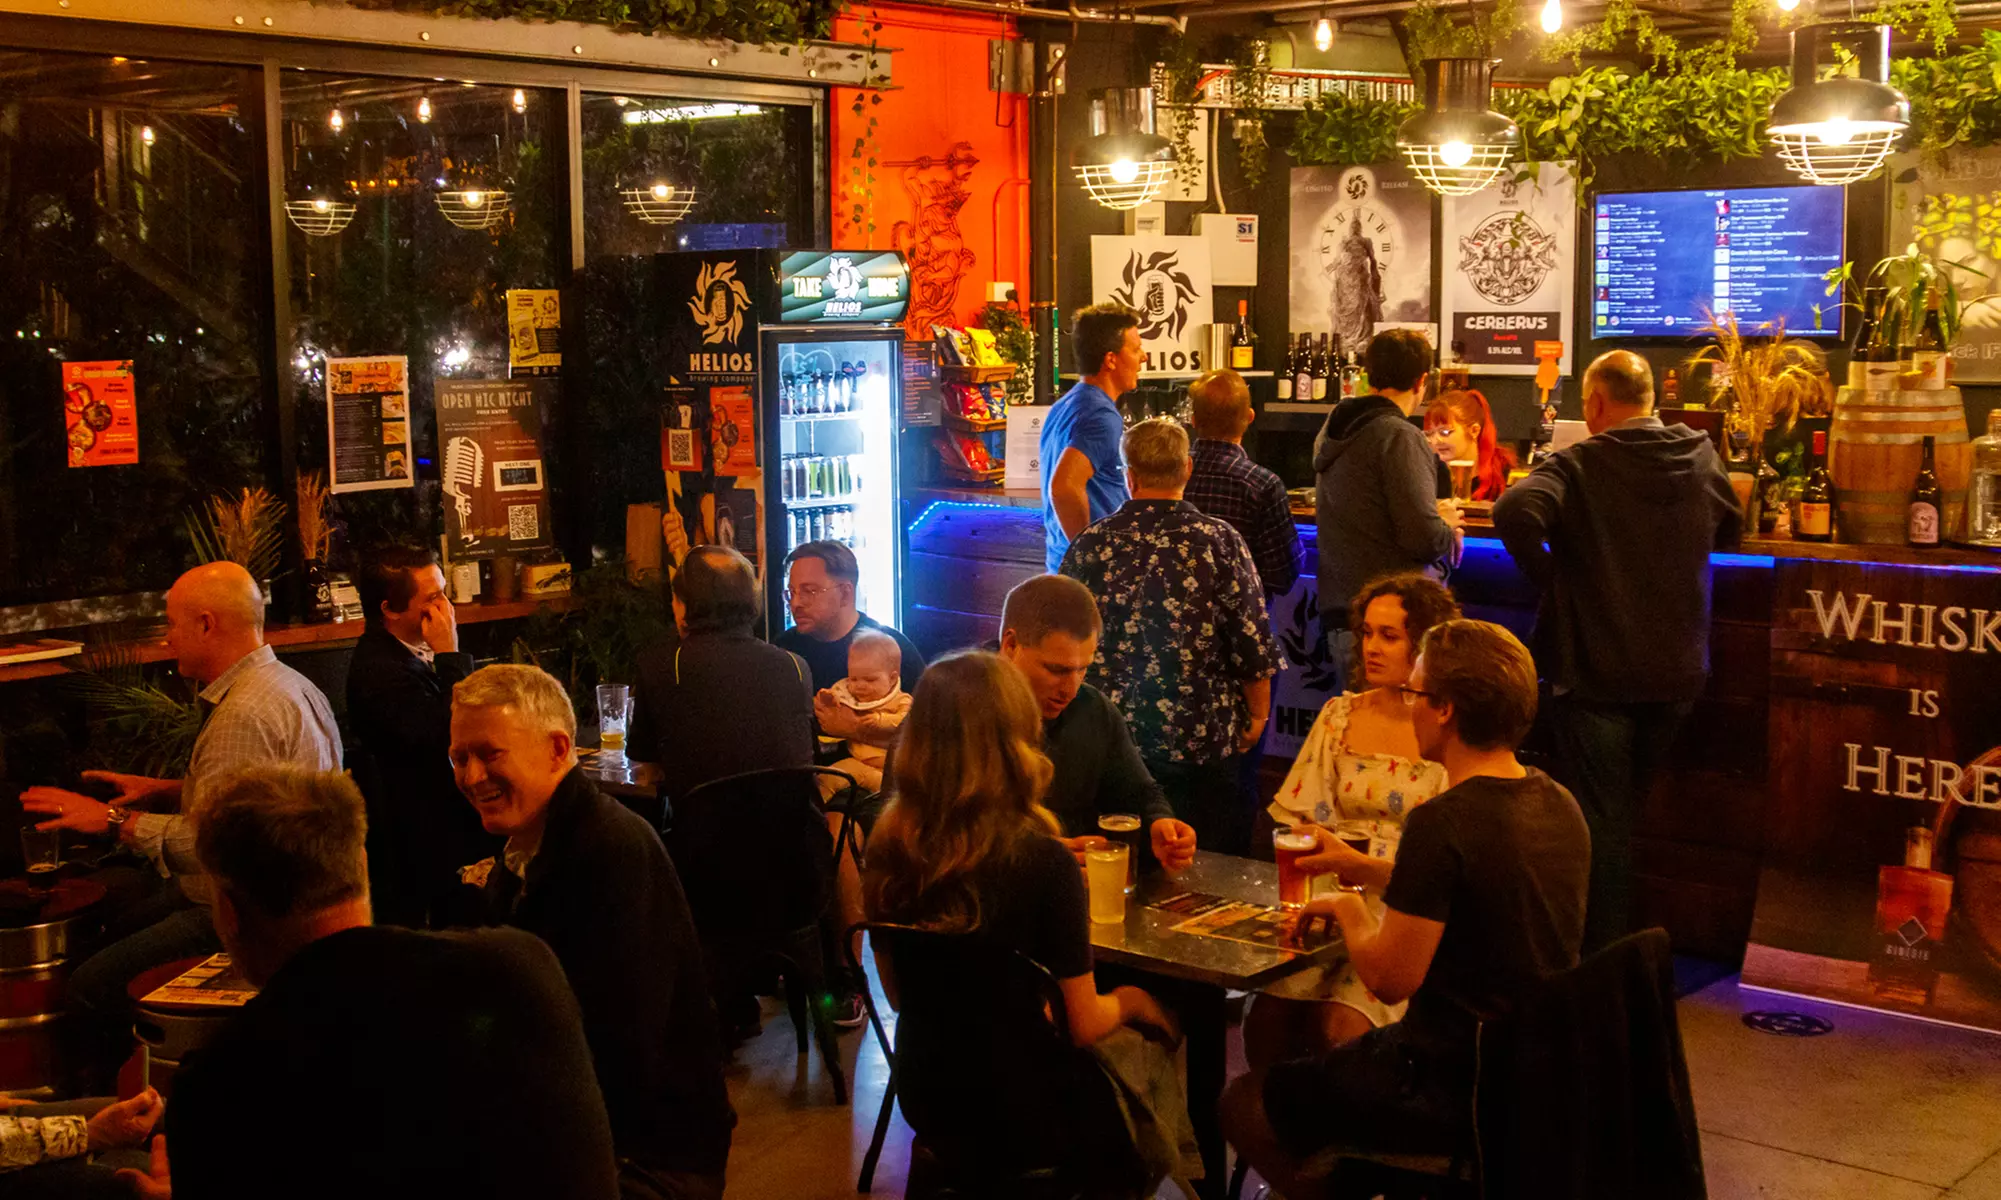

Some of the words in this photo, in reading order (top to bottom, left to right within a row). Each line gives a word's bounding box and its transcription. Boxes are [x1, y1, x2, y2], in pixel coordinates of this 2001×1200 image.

[1238, 222, 1253, 234] S1
[792, 277, 822, 298] TAKE
[867, 277, 899, 298] HOME
[826, 301, 862, 313] HELIOS
[1464, 315, 1548, 330] CERBERUS
[689, 352, 753, 372] HELIOS
[1147, 351, 1200, 371] LIOS
[721, 375, 754, 383] company
[442, 393, 472, 409] OPEN
[475, 391, 496, 408] MIC
[498, 390, 532, 407] NIGHT
[1908, 688, 1940, 719] IS
[1842, 742, 2001, 812] HERE
